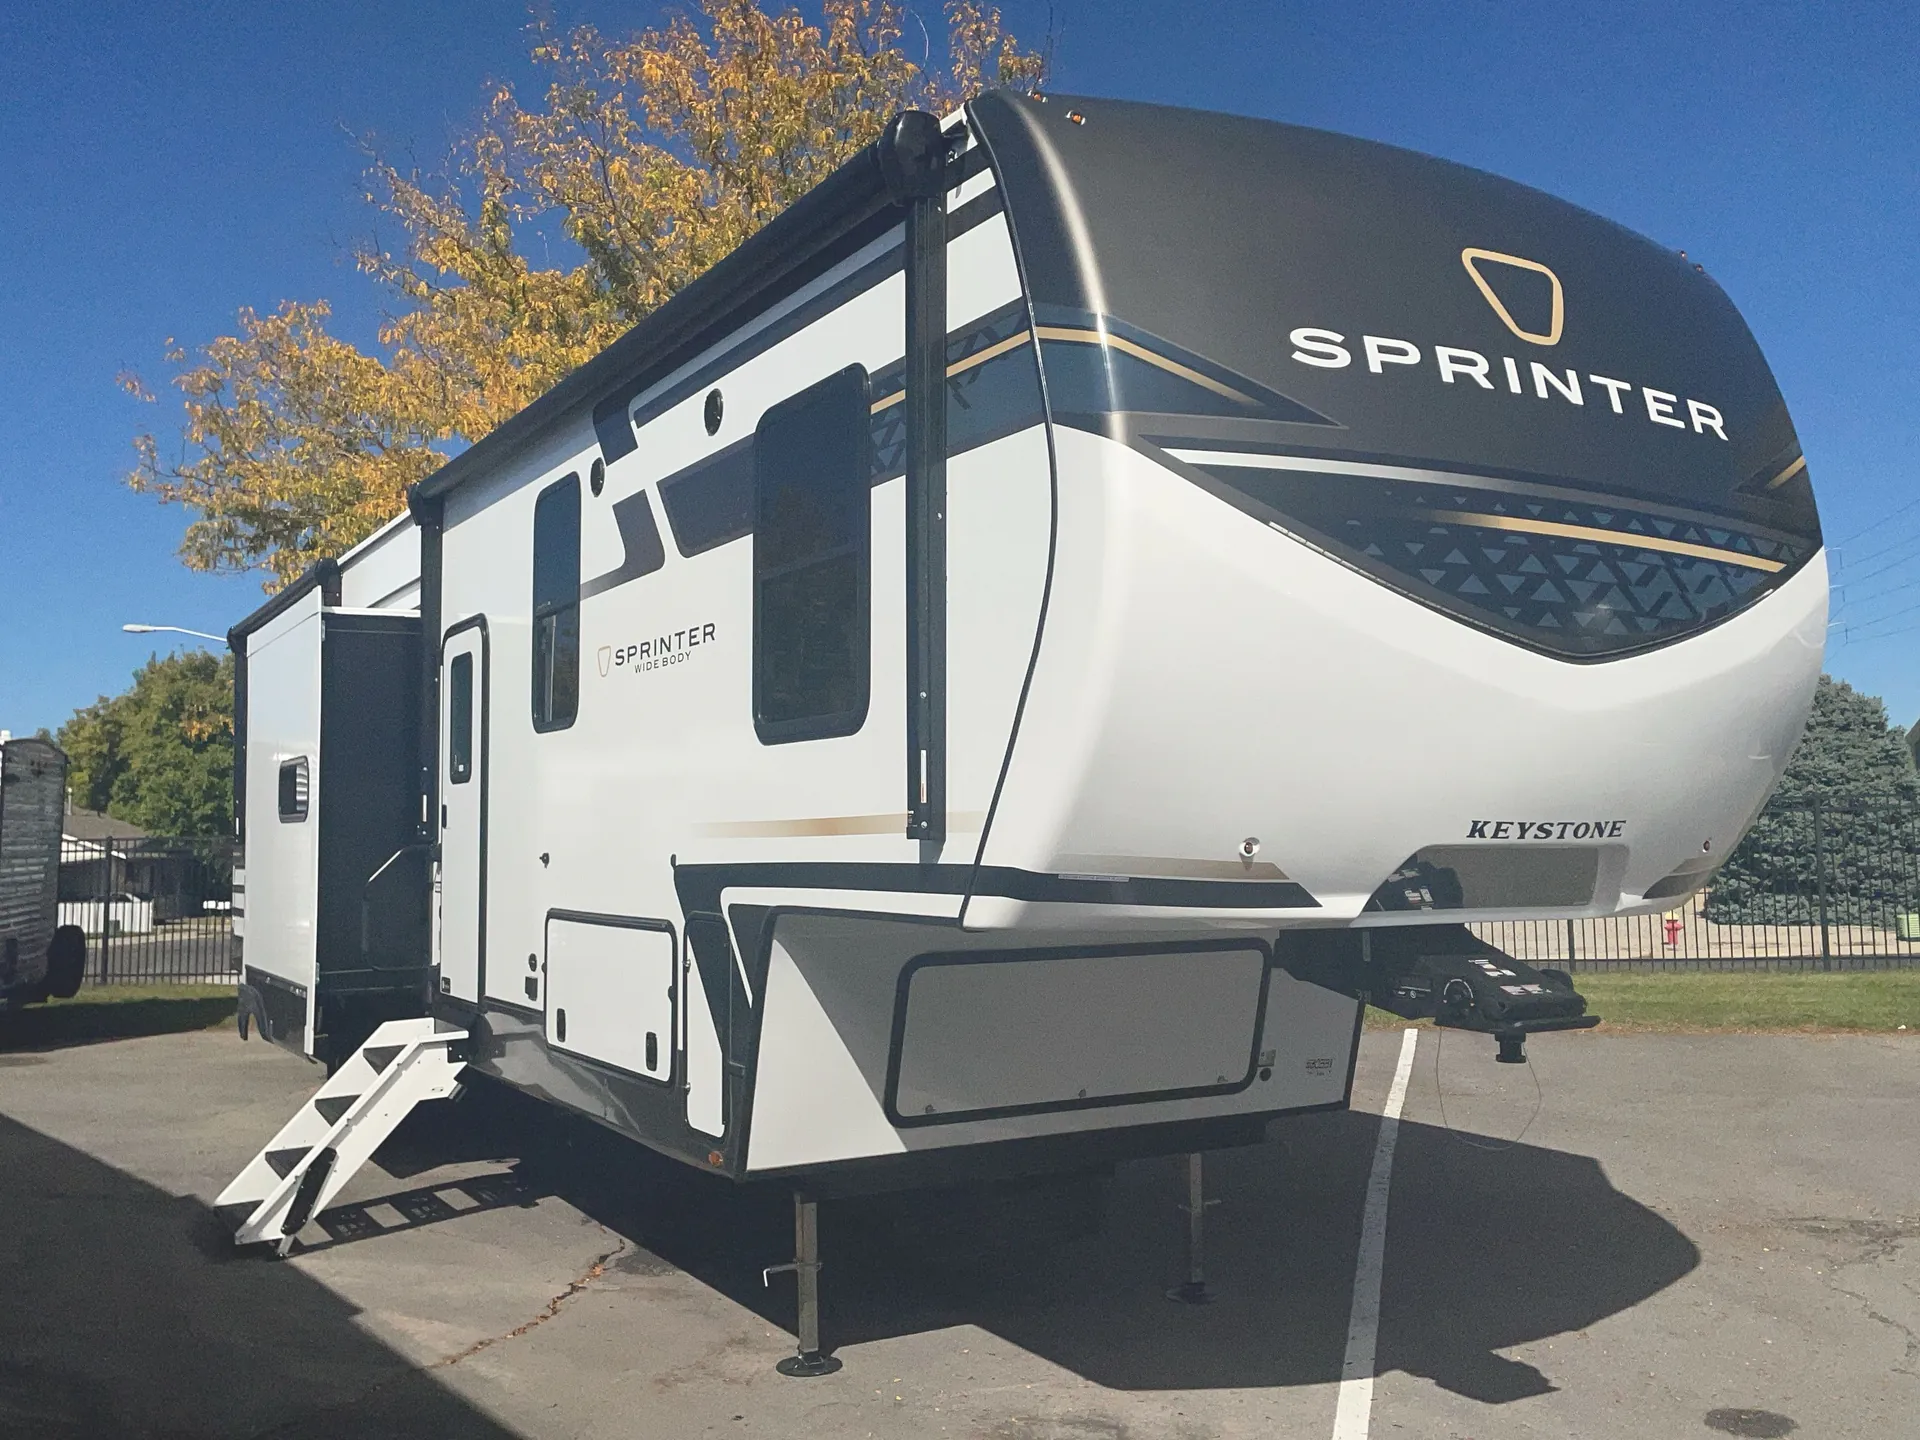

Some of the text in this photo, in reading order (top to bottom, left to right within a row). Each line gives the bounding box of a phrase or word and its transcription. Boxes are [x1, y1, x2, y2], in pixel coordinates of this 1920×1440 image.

[1289, 327, 1729, 442] SPRINTER
[615, 622, 716, 666] SPRINTER
[1466, 819, 1627, 840] KEYSTONE
